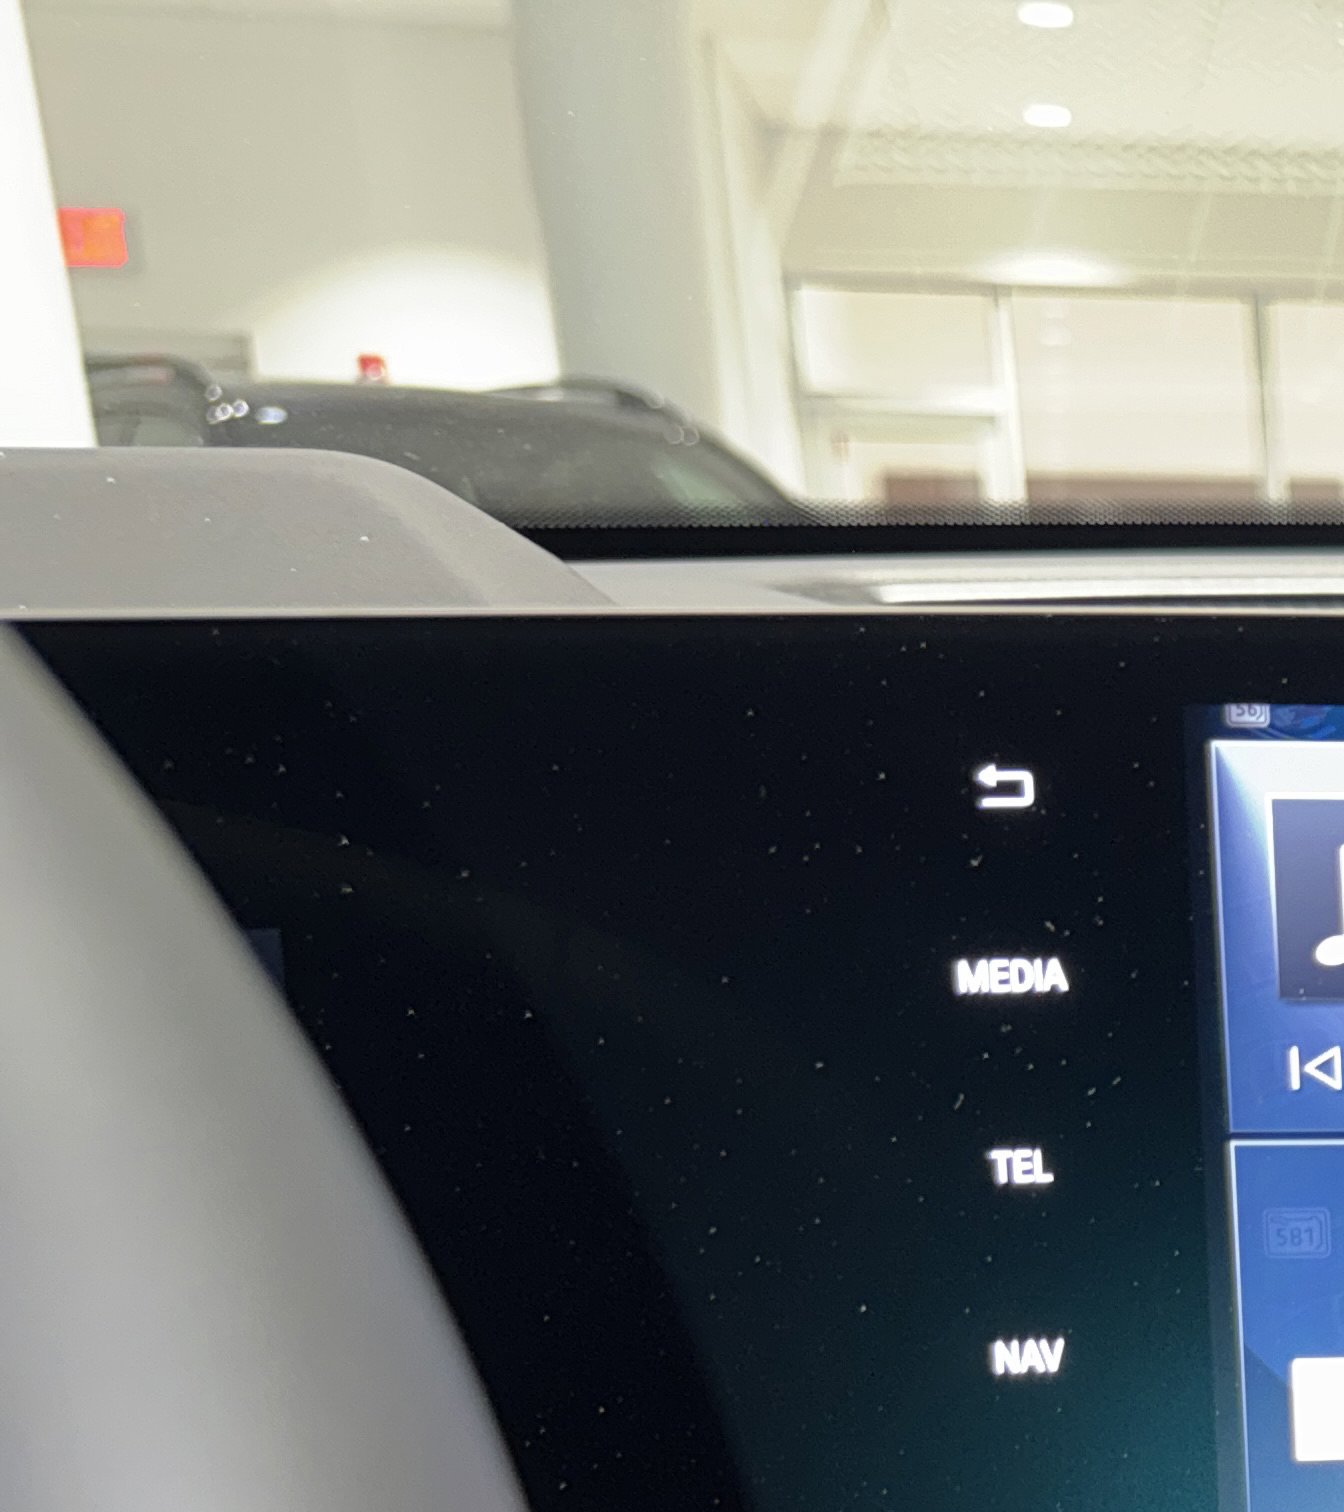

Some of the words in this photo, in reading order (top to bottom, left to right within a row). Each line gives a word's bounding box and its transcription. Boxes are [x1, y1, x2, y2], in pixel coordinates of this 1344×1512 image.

[956, 956, 1070, 994] MEDIA
[989, 1148, 1055, 1185] TEL
[1275, 1227, 1314, 1247] 581
[992, 1337, 1066, 1375] NAV
